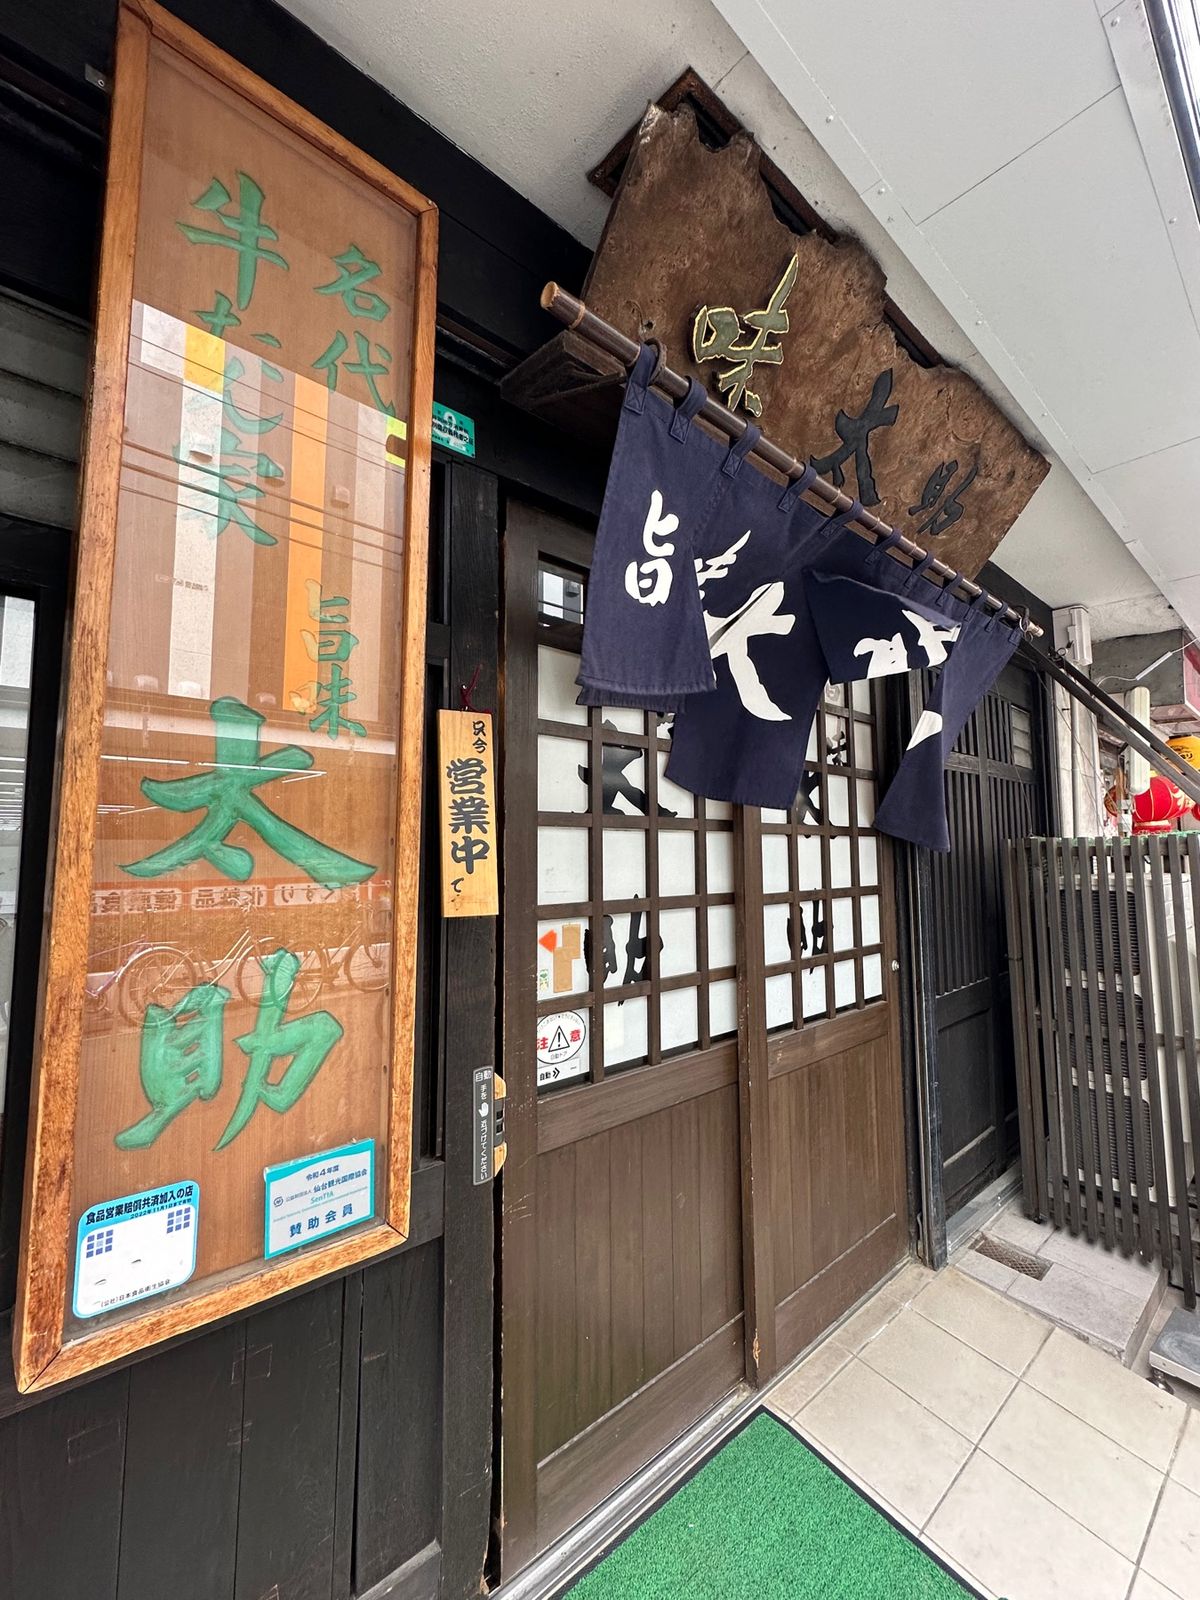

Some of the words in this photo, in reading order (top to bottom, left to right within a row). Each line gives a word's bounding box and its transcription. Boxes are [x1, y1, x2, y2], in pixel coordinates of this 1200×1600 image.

[311, 243, 395, 419] 名代
[288, 578, 368, 741] 旨味
[446, 757, 490, 875] 営業中
[114, 696, 378, 1152] 太助
